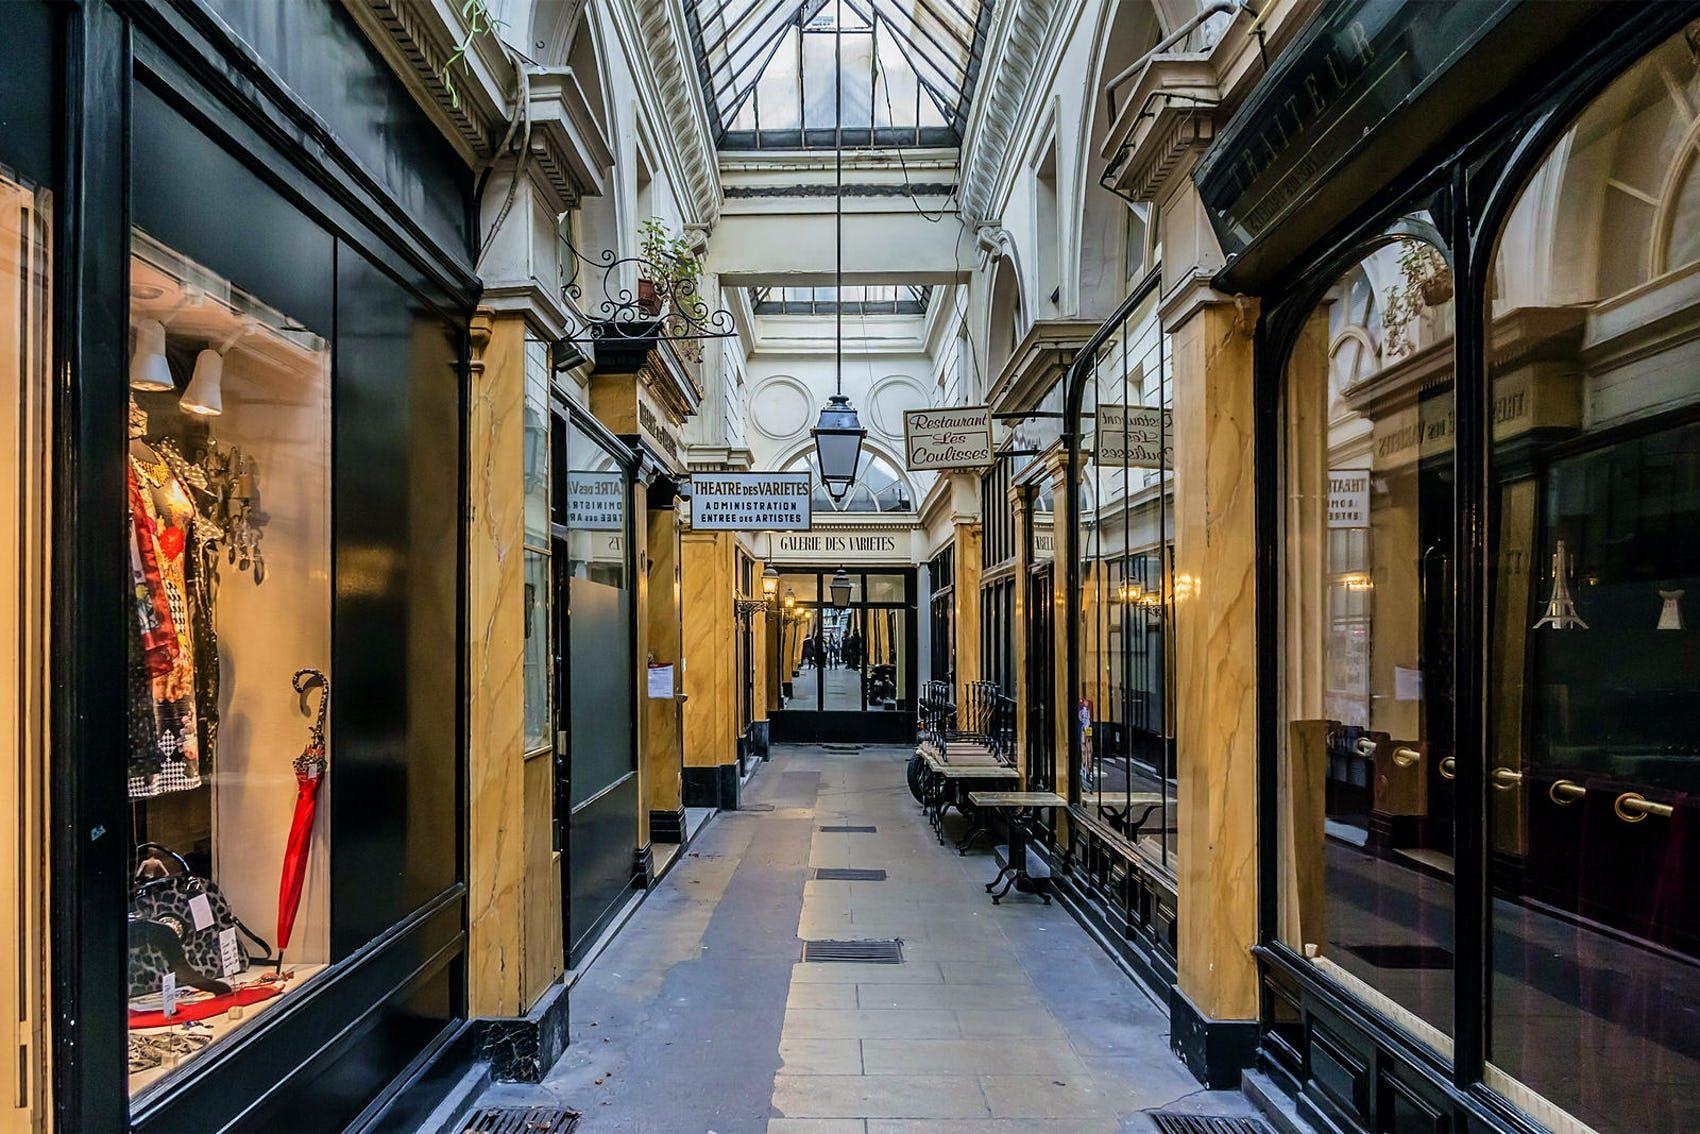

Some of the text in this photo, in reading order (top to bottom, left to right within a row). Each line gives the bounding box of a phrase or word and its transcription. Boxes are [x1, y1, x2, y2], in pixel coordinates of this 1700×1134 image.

[909, 413, 987, 431] Restaurant
[932, 432, 966, 446] Les
[912, 446, 988, 465] Coulisses
[693, 481, 809, 496] THEATRE DES VARIETES
[705, 502, 797, 510] ADMINISTRATION
[701, 514, 736, 523] ENTREE
[755, 514, 802, 523] ARTISTES
[780, 536, 895, 551] GALERIE DES VARIETES
